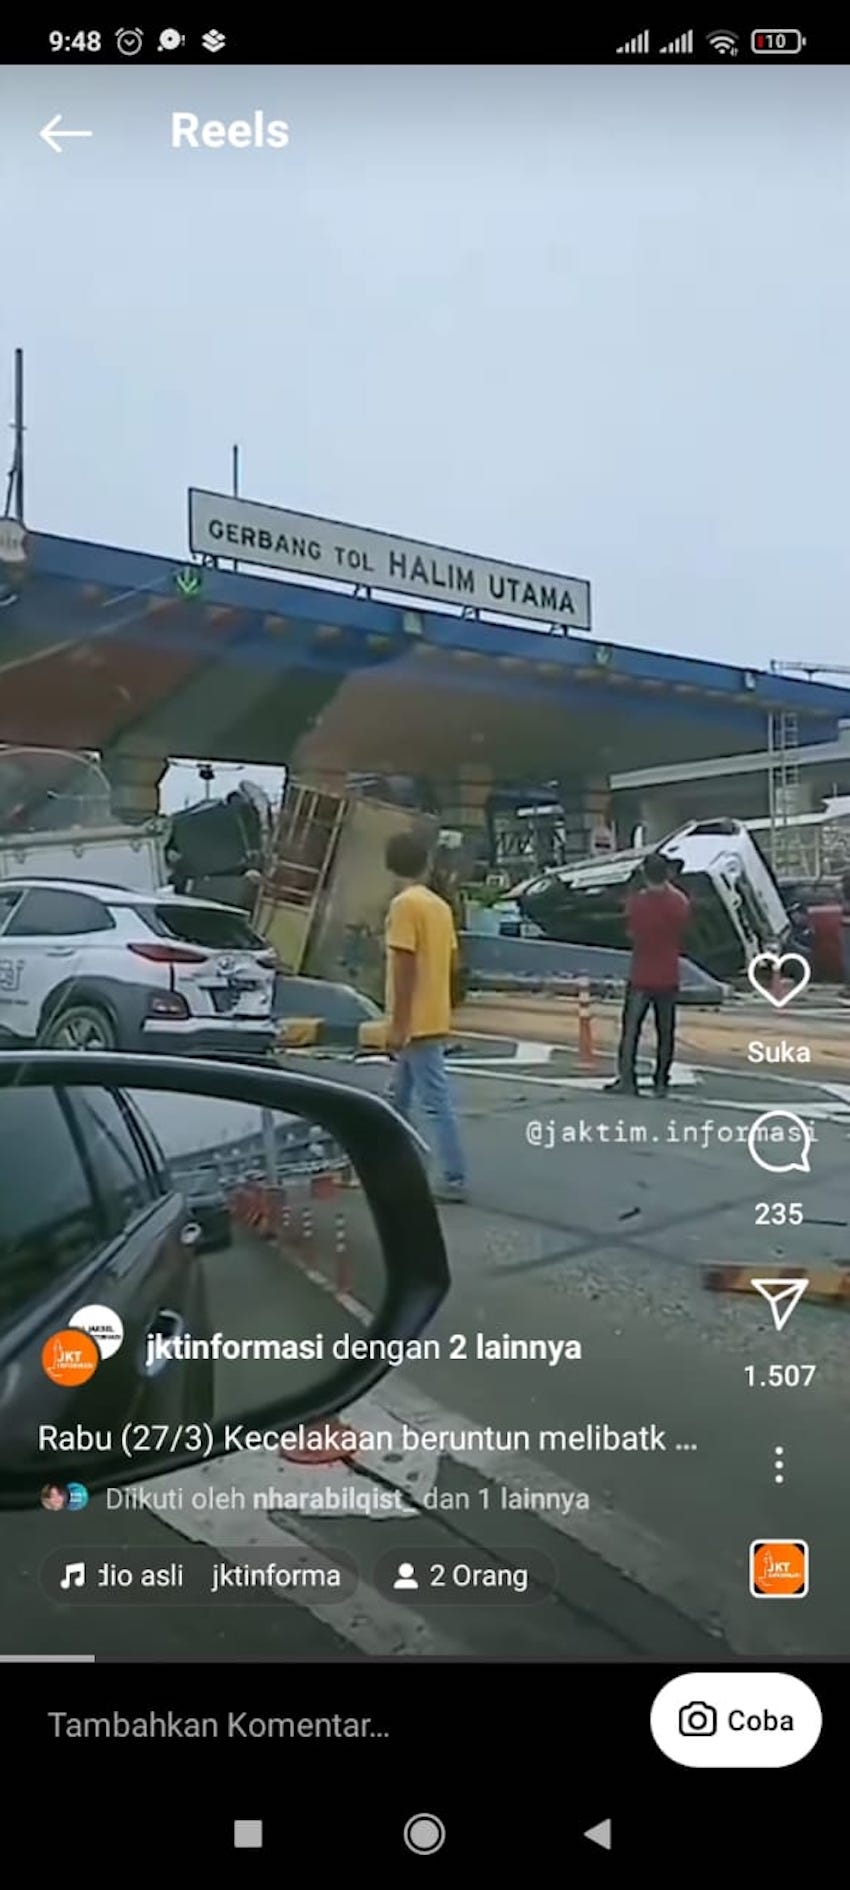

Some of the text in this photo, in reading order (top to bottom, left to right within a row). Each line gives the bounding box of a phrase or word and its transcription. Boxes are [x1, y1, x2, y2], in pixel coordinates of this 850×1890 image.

[208, 519, 576, 615] GERBANG TOL HALIM UTAMA
